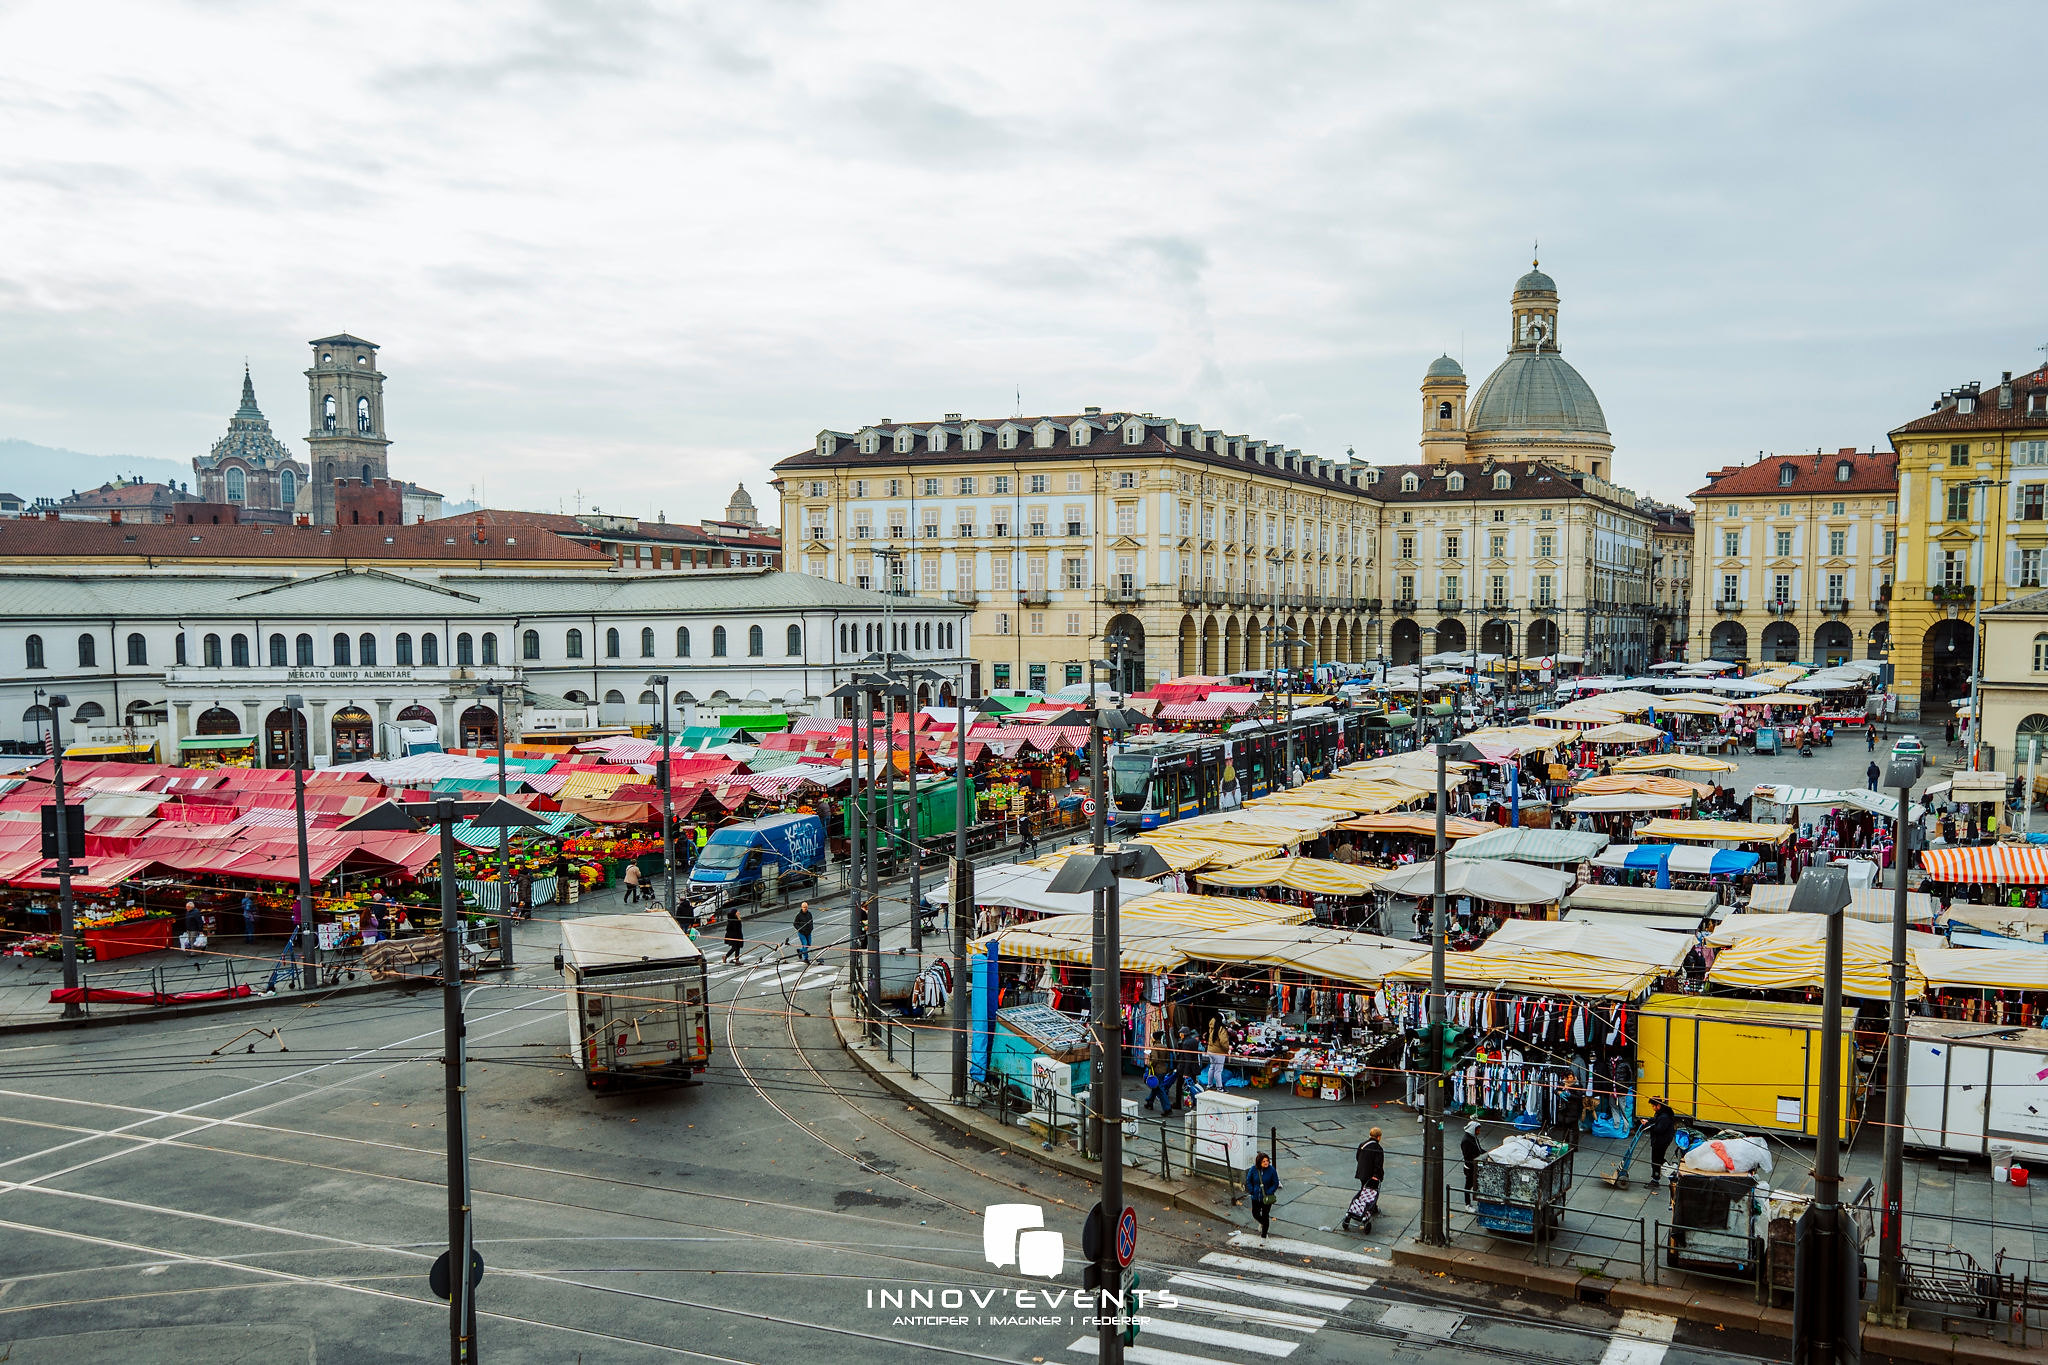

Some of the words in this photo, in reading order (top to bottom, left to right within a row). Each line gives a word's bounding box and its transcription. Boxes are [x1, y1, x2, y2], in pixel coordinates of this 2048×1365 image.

[288, 671, 325, 679] MERCATO
[329, 671, 358, 679] QUINTO
[364, 671, 411, 679] ALIMENTARE
[1085, 803, 1095, 811] 30
